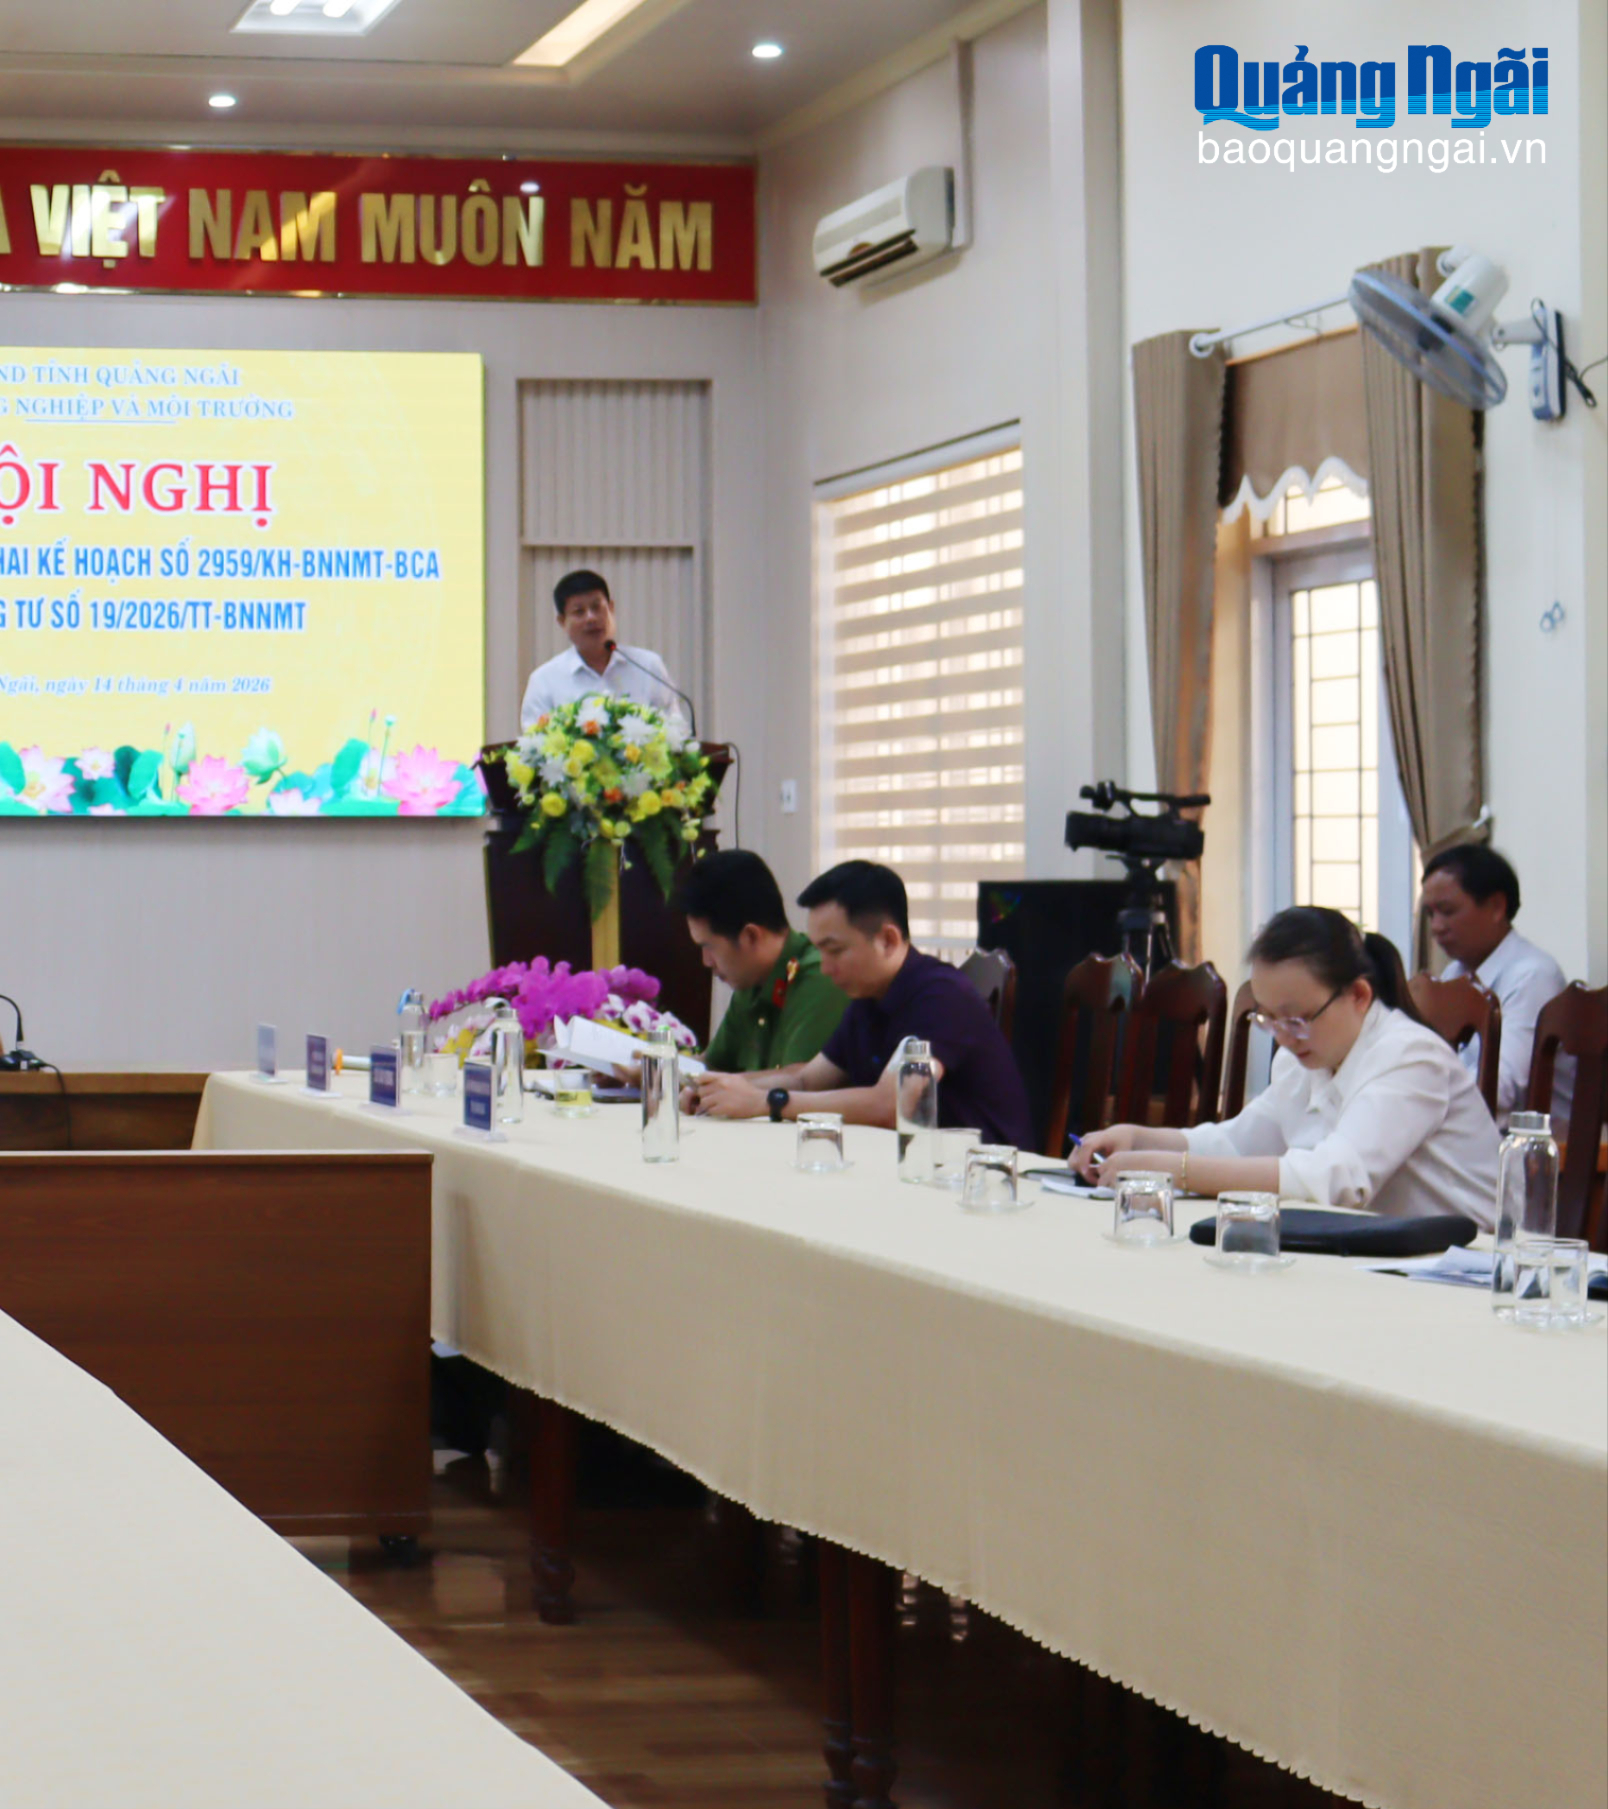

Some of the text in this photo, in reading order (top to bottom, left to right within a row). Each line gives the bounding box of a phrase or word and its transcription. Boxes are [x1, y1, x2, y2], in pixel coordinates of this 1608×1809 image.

[30, 169, 166, 269] VIỆT
[188, 187, 337, 262] NAM
[360, 179, 545, 267] MUÔN
[570, 183, 713, 271] NĂM
[32, 359, 90, 385] TỈNH
[95, 359, 178, 387] QUẢNG
[15, 395, 105, 421] NGHIỆP
[111, 394, 141, 417] VÀ
[146, 394, 191, 418] MÔI
[197, 394, 294, 419] TRƯỜNG
[86, 462, 274, 528] NGHỊ
[37, 537, 68, 576] KẾ
[74, 548, 152, 585] HOẠCH
[160, 537, 191, 577] SỐ
[197, 548, 441, 579] 2959/KH-BNNMT-BCA
[15, 598, 45, 629] TƯ
[50, 589, 82, 630] SỐ
[90, 600, 307, 631] 19/2026/TT-BNNMT
[45, 678, 89, 695] ngày
[94, 676, 113, 693] 14
[117, 676, 169, 695] tháng
[173, 677, 184, 693] 4
[188, 677, 227, 693] năm
[231, 676, 272, 694] 2026
